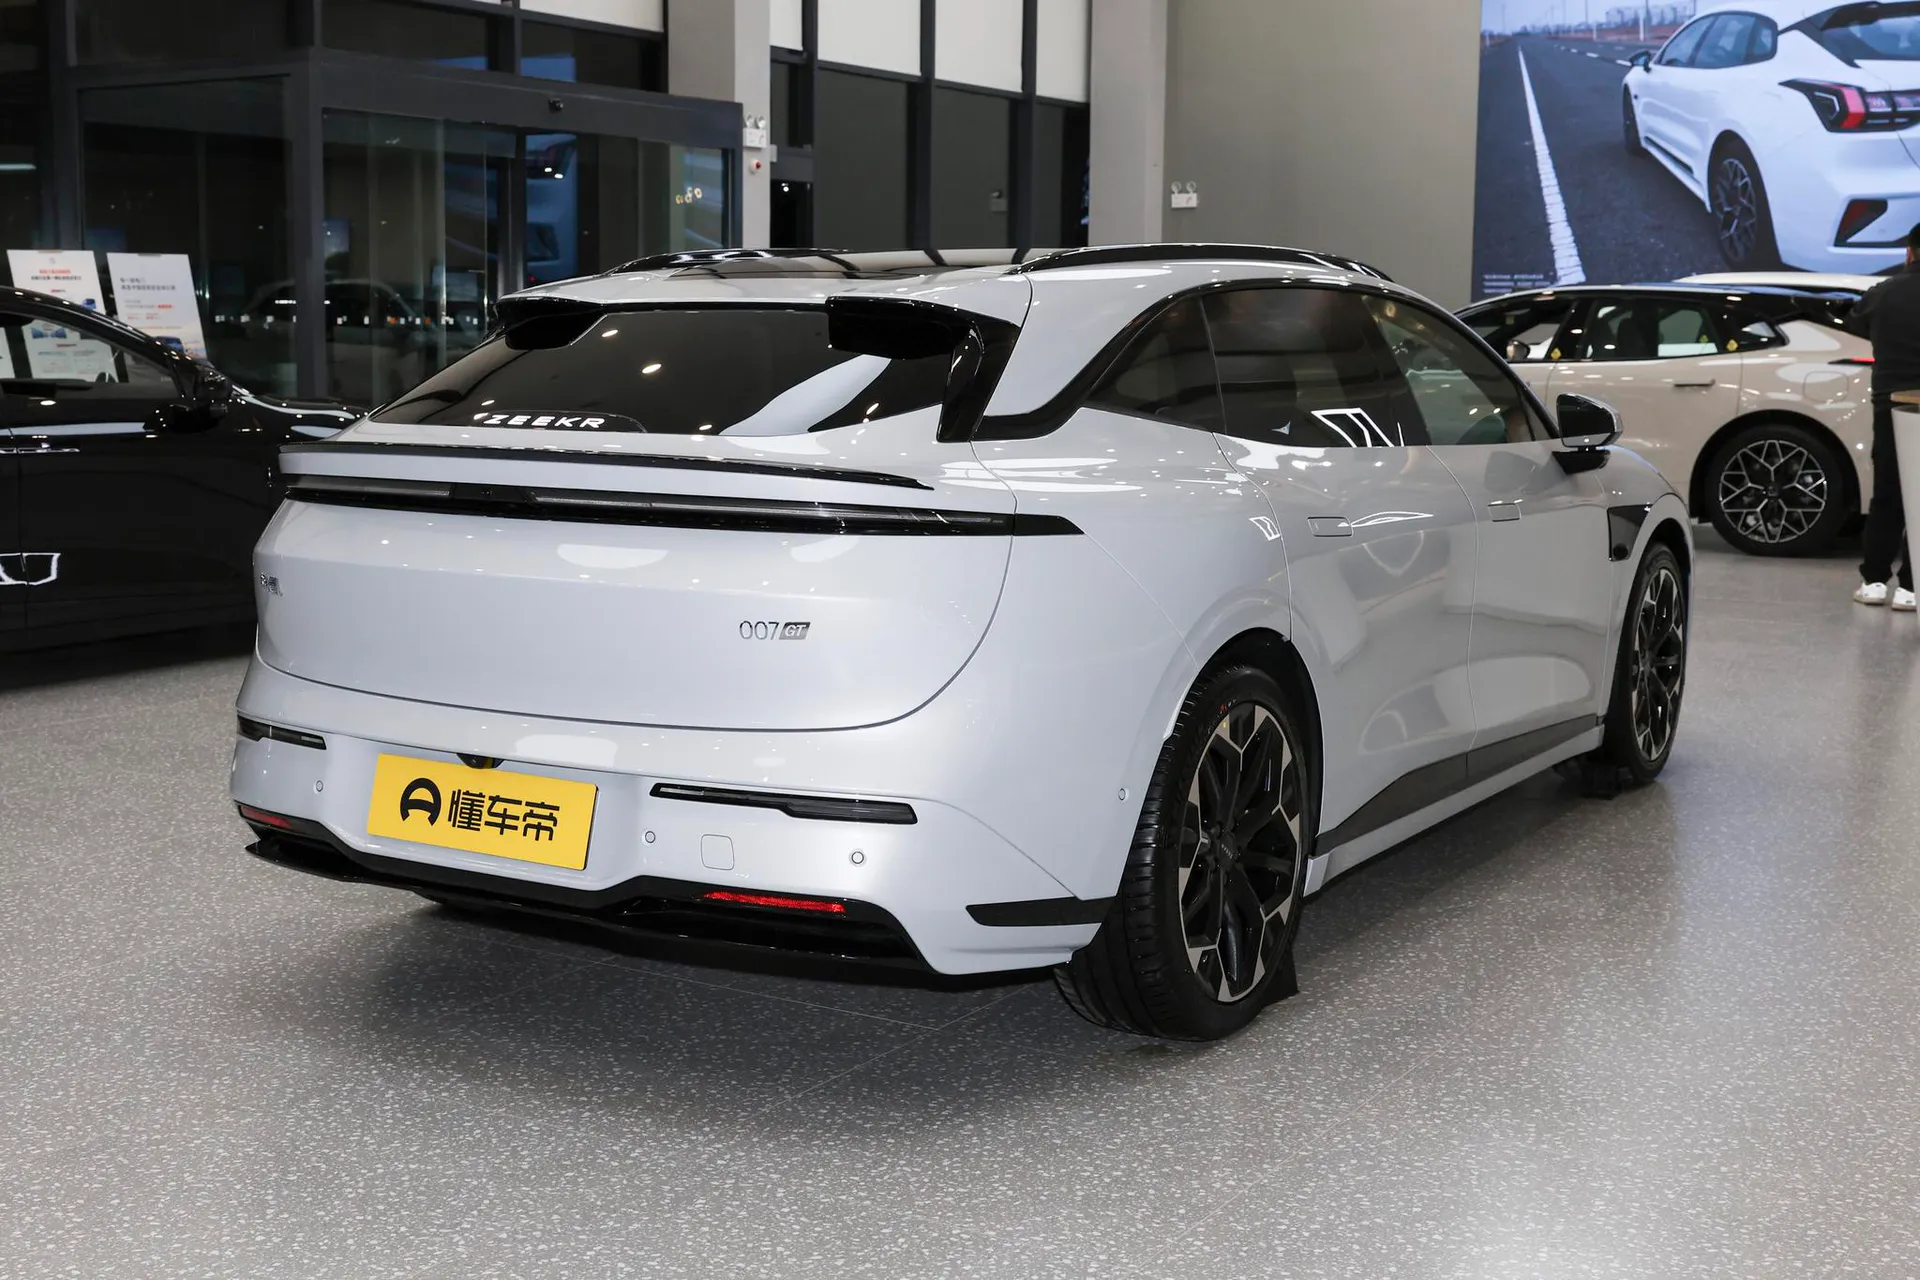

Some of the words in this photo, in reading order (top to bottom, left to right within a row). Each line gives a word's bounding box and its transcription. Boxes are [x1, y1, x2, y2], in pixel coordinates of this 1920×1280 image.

[483, 414, 605, 429] ZEEKR
[739, 620, 780, 640] 007
[782, 623, 808, 638] GT
[447, 789, 560, 841] 懂车帝
